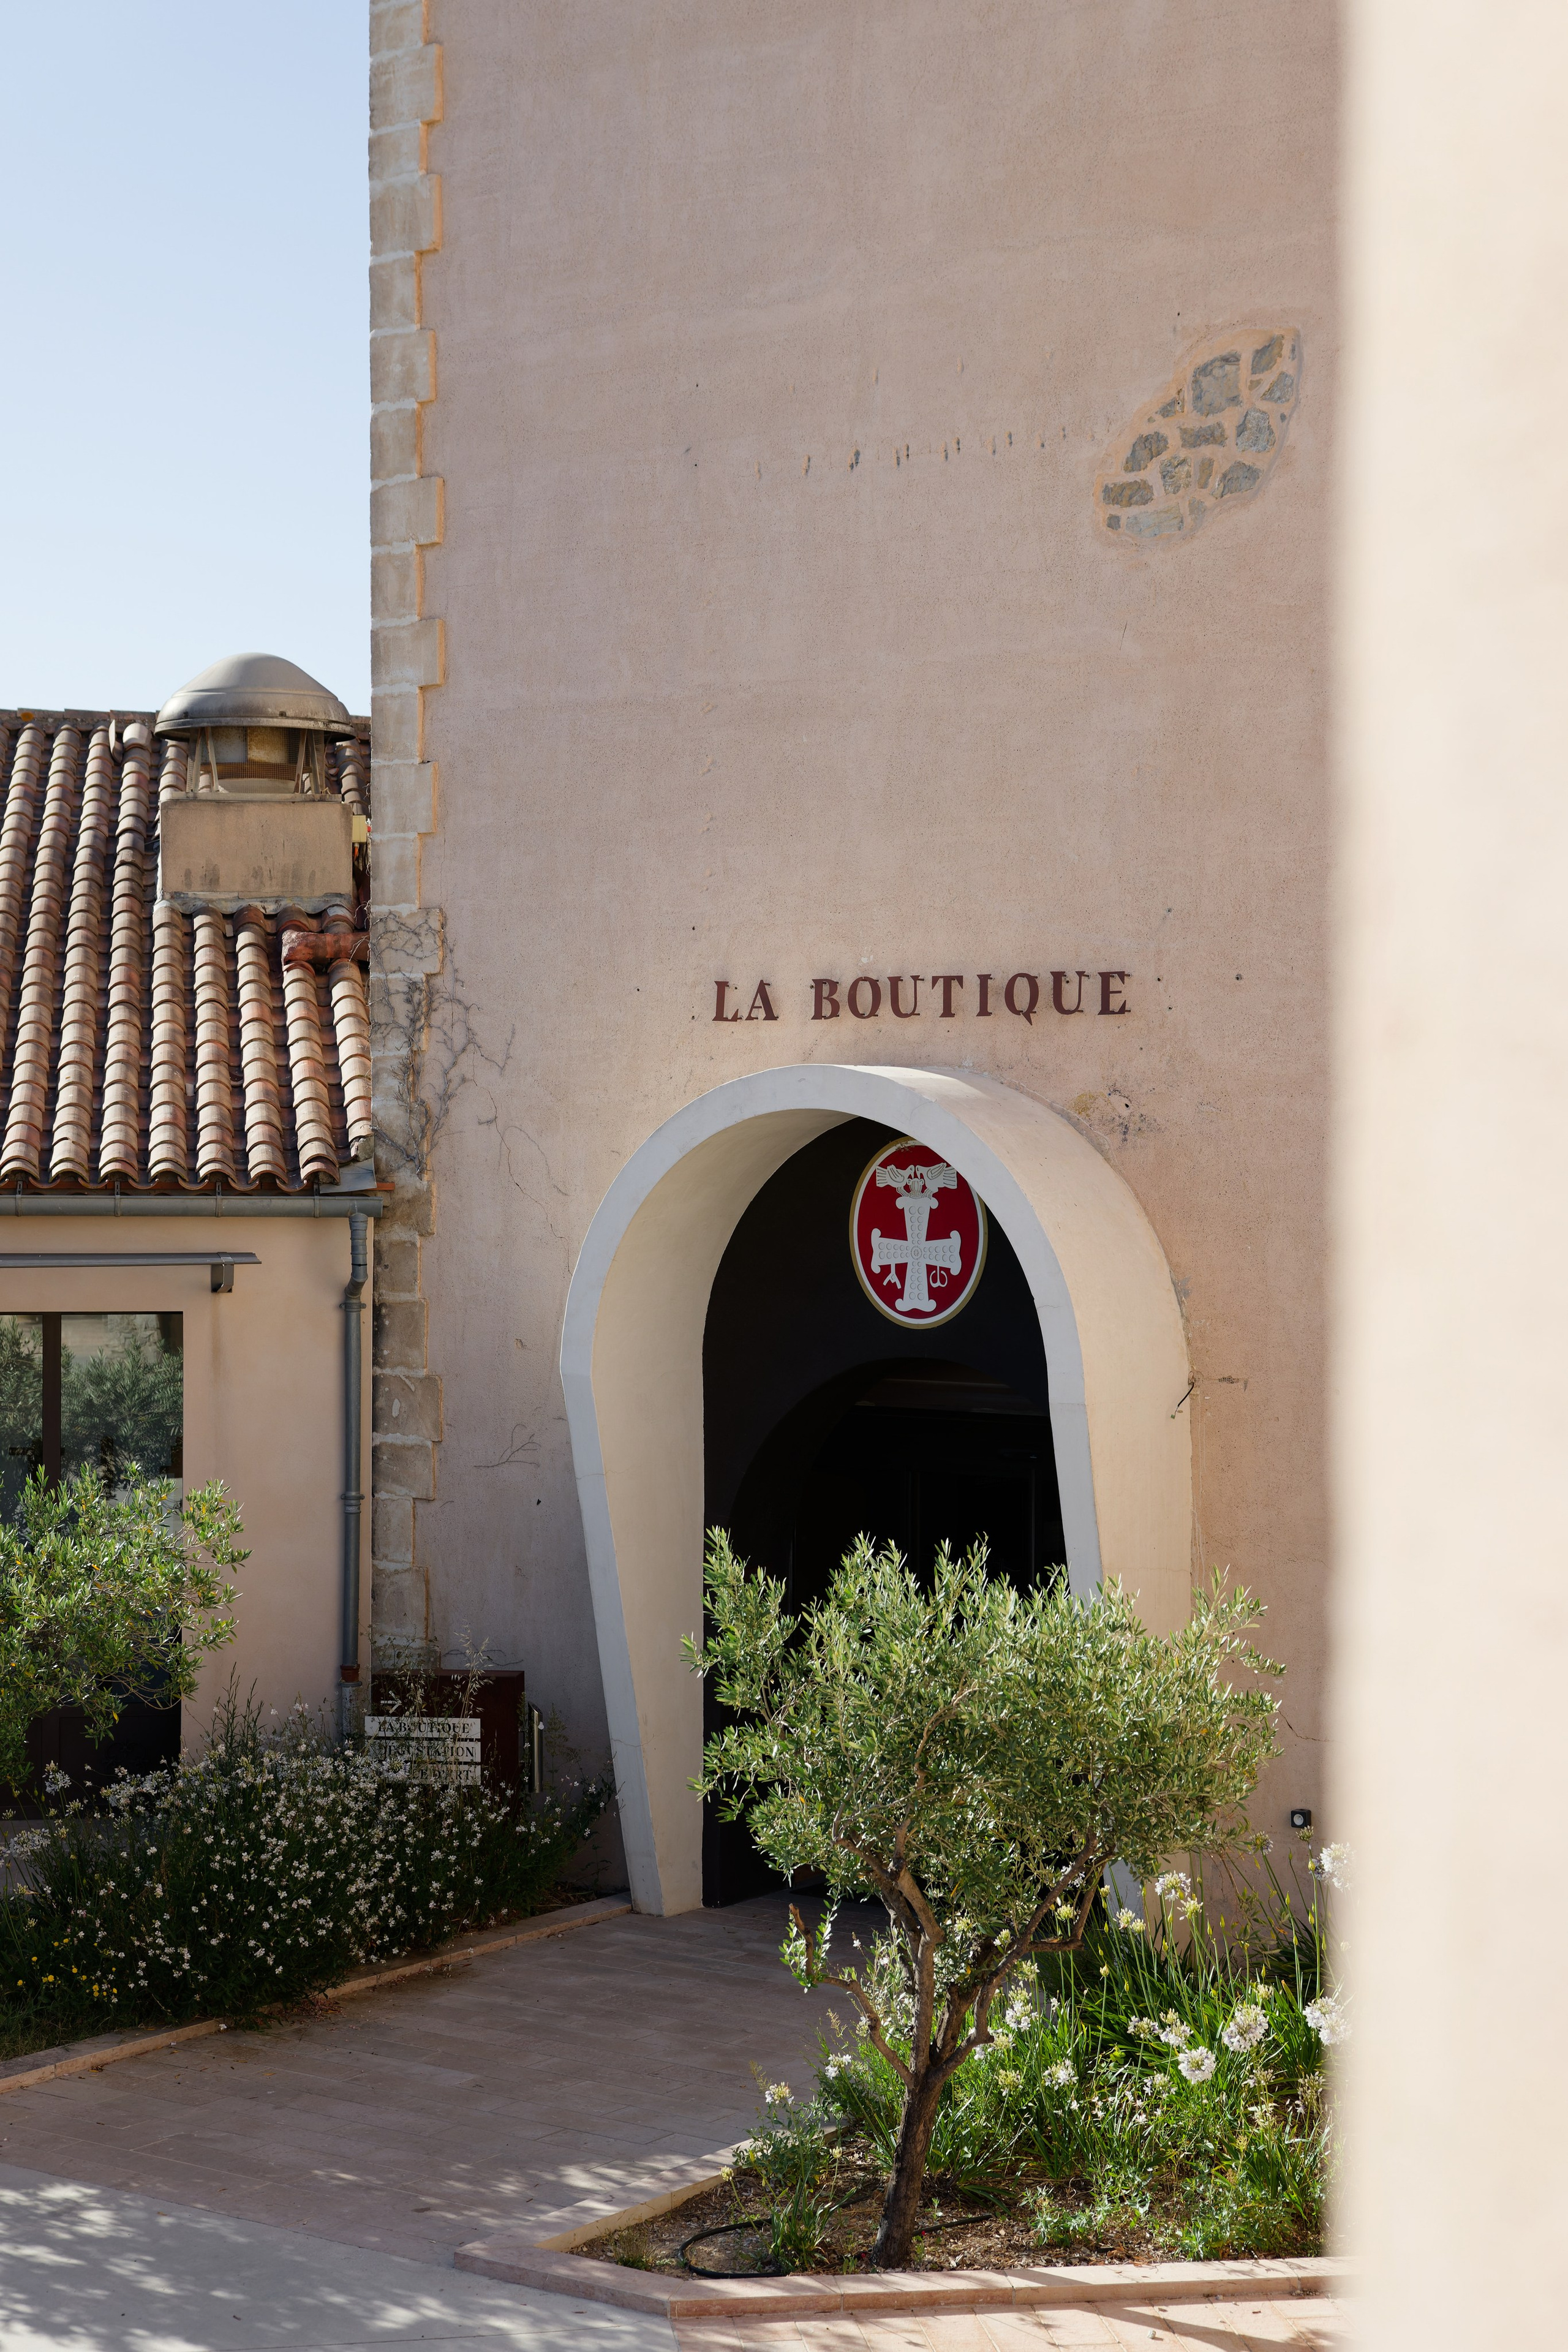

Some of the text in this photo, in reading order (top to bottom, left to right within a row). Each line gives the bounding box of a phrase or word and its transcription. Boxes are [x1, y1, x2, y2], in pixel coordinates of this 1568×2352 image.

[712, 971, 1130, 1026] LA BOUTIQUE
[378, 1722, 394, 1732] LA
